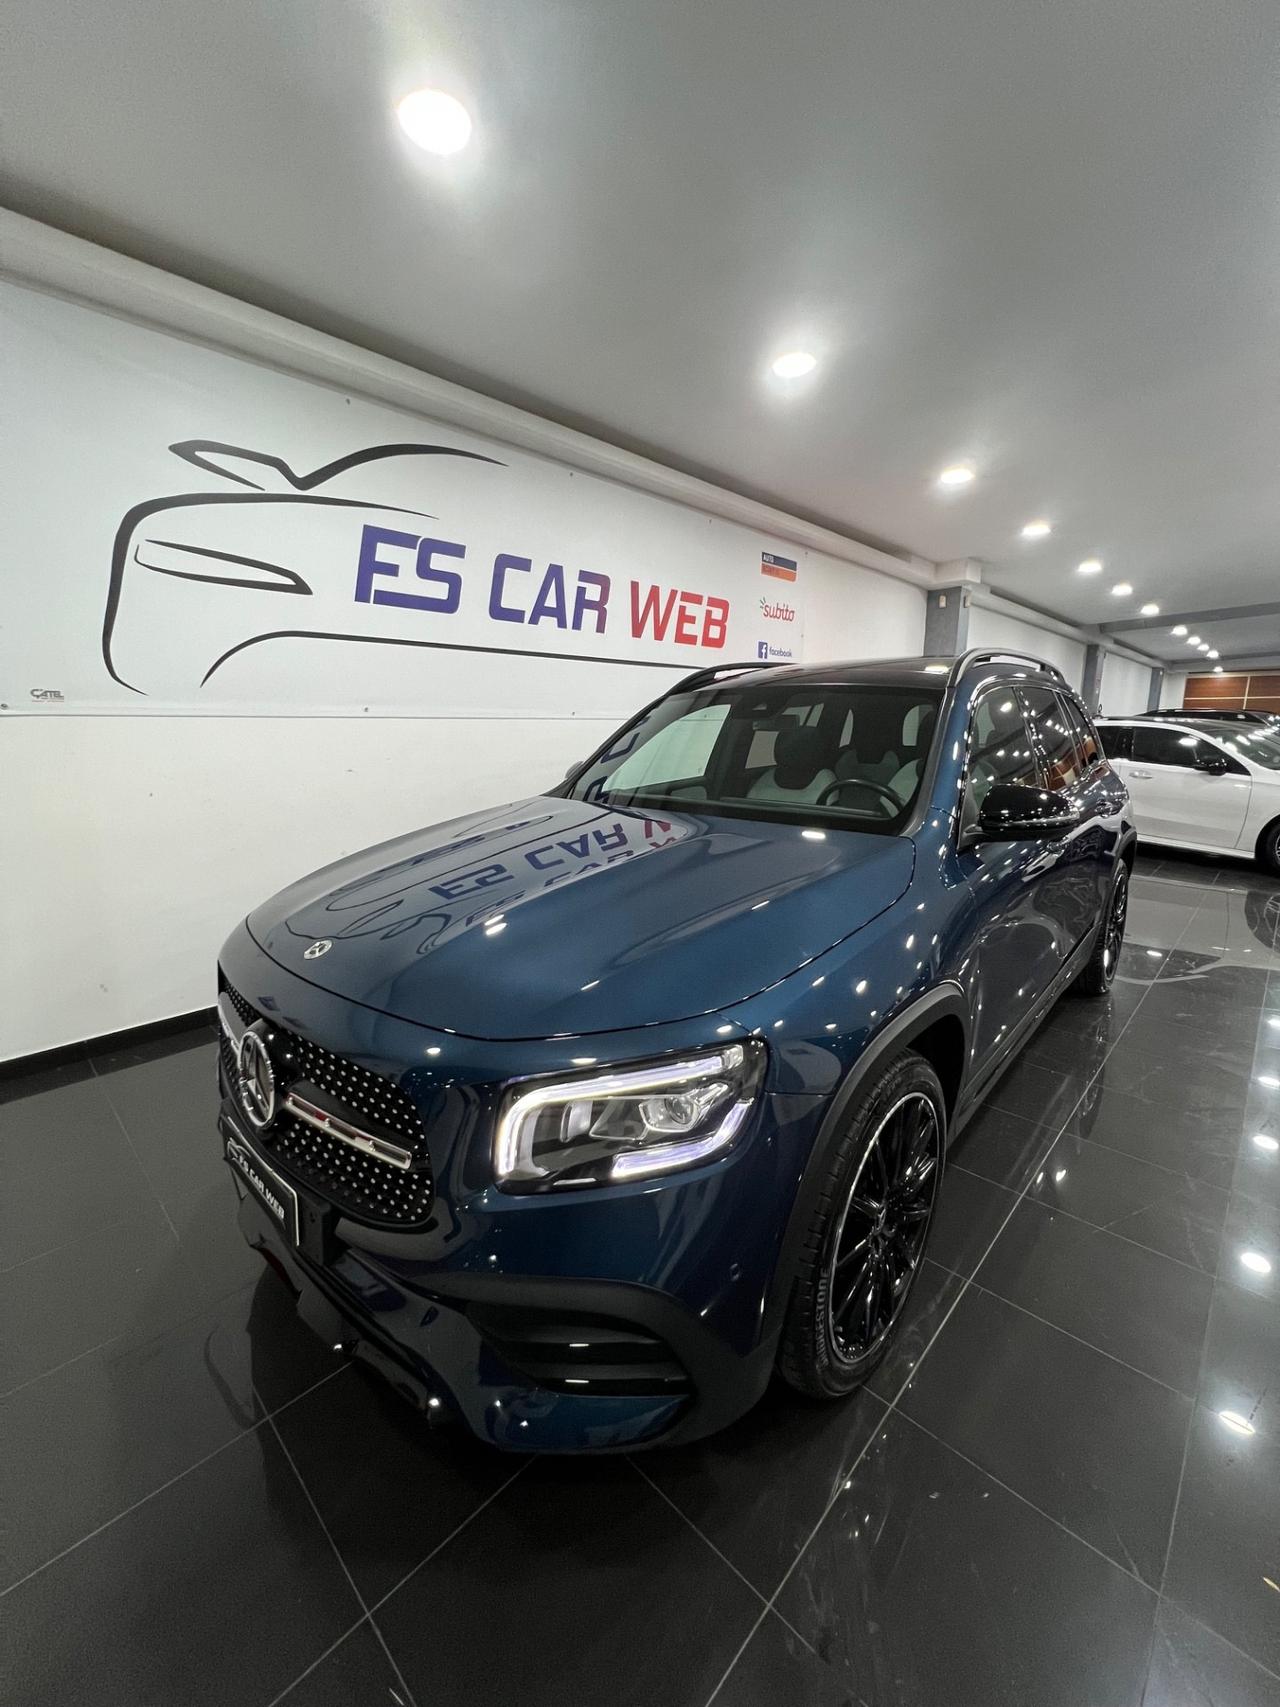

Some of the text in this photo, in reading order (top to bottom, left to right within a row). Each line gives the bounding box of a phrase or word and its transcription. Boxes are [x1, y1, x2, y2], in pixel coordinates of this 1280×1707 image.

[354, 524, 729, 649] ES CAR WEB
[763, 604, 795, 621] subito
[769, 646, 792, 658] facebook
